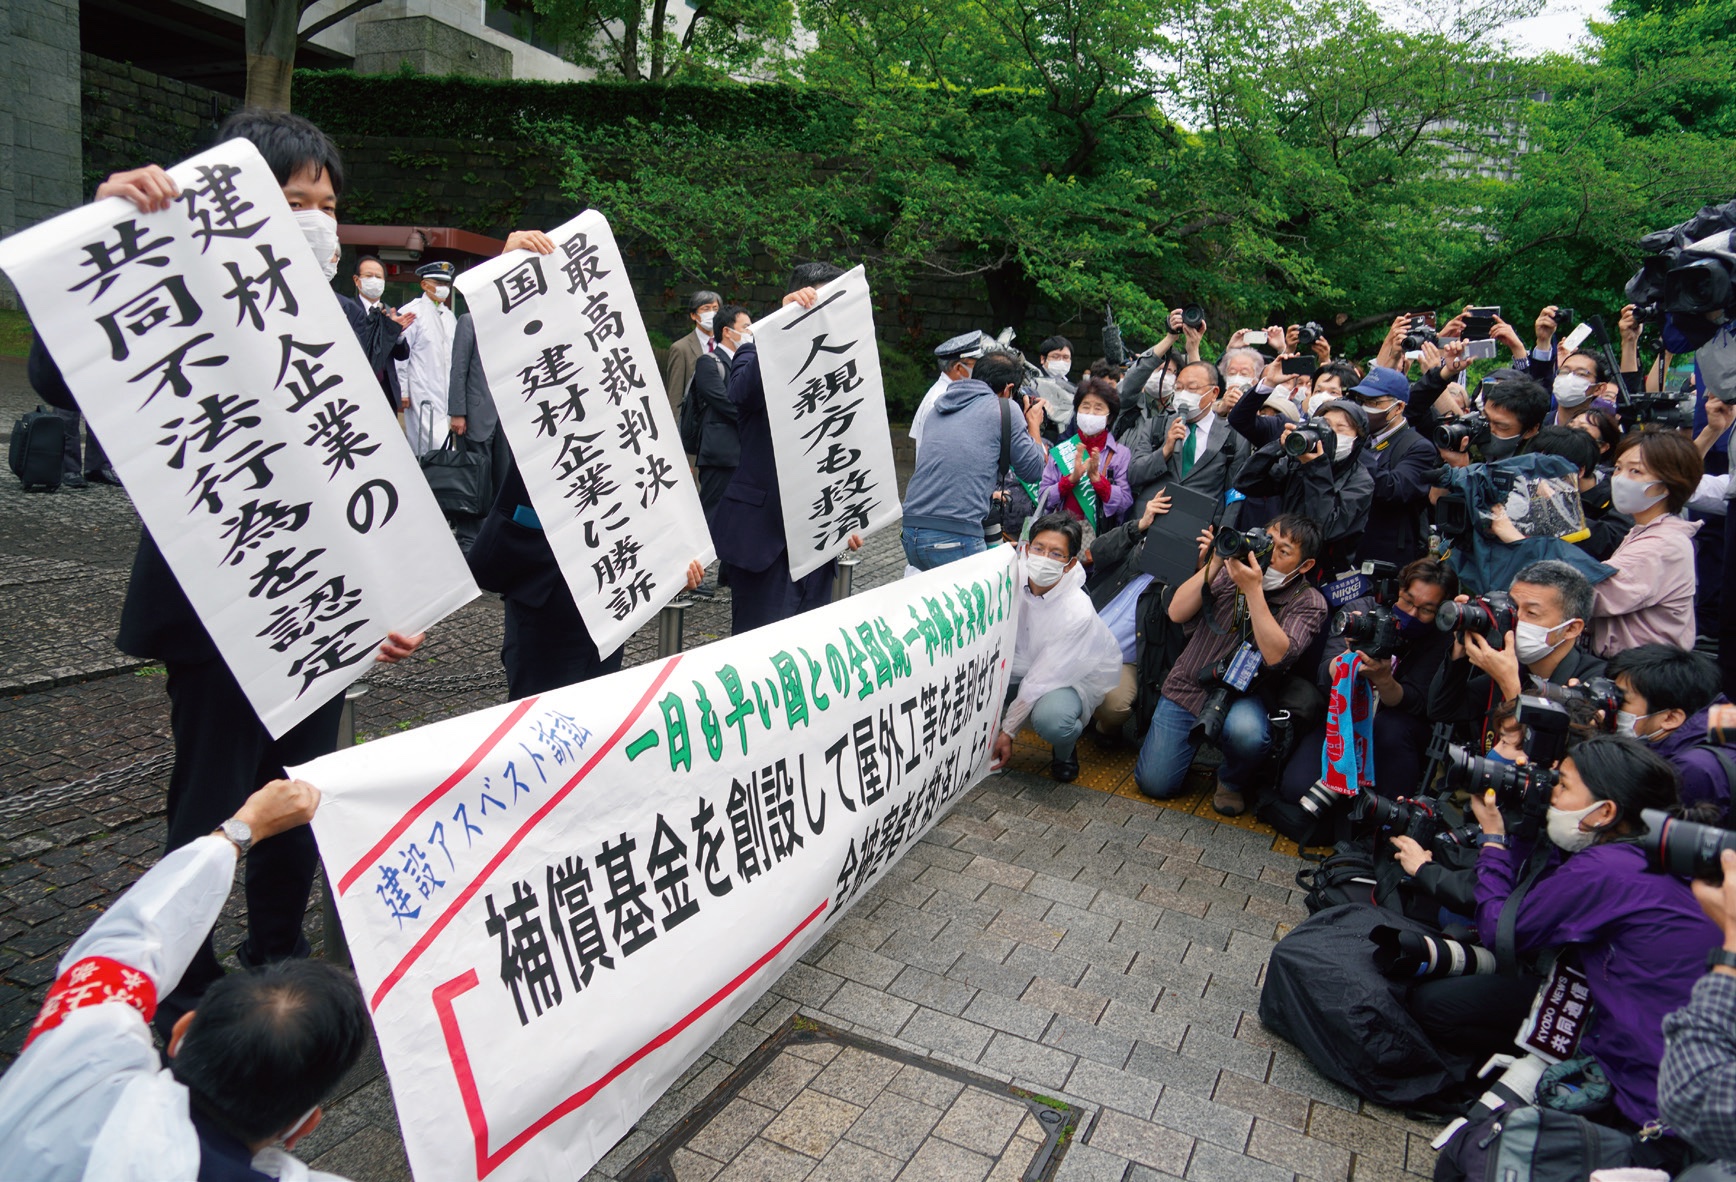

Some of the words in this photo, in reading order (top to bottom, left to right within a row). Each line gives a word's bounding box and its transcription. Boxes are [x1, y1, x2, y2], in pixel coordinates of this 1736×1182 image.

[69, 219, 384, 701] 共同不法行為を認定
[180, 163, 398, 534] 建材企業の
[494, 257, 656, 621] 国・建材企業に勝訴
[559, 233, 678, 509] 最高裁判決
[782, 290, 881, 552] 一人親方も救済
[626, 565, 1012, 773] 一日も早い国との全国統一和解を実現しよう
[1332, 581, 1361, 599] NIKKEI
[1341, 591, 1359, 603] PRESS
[375, 711, 594, 930] 建設アスベスト訴訟
[484, 635, 1001, 1026] 補償基金を創設して屋外工等を差別せず
[1536, 1007, 1556, 1043] KYODO
[1550, 975, 1568, 1004] NEWS
[1551, 982, 1590, 1053] 共同通信
